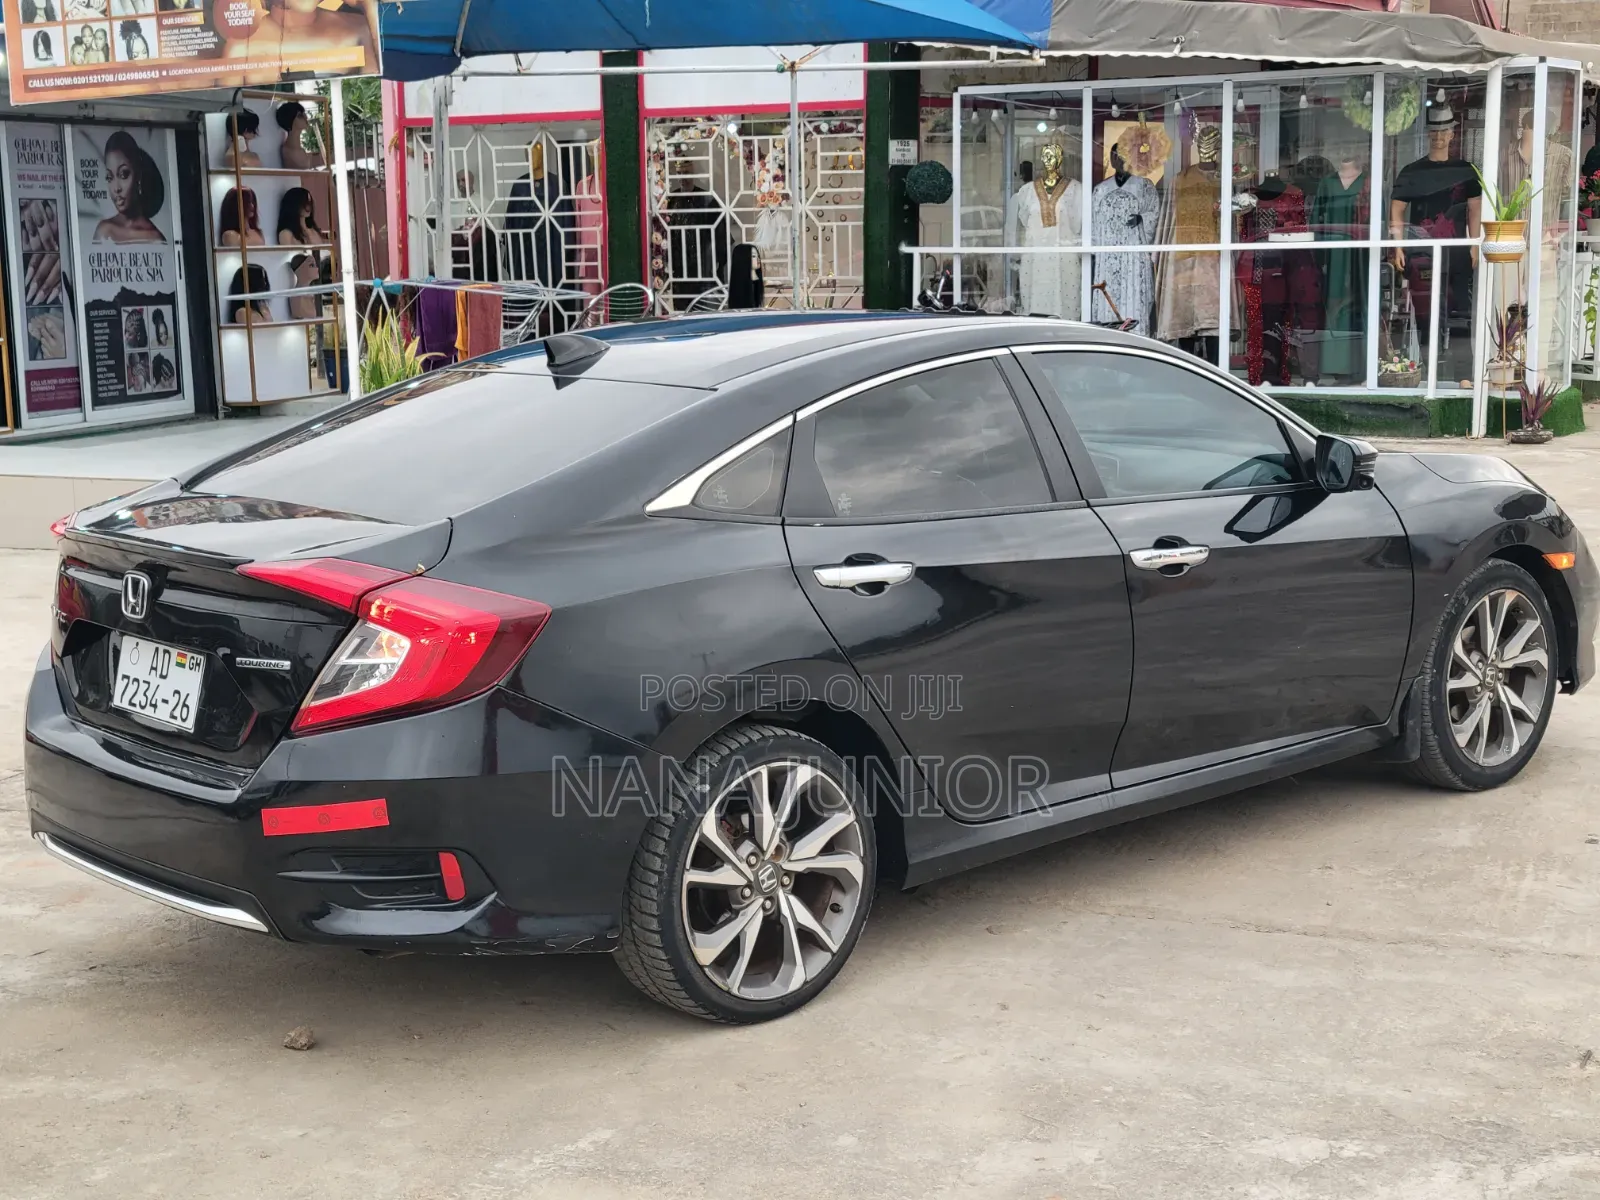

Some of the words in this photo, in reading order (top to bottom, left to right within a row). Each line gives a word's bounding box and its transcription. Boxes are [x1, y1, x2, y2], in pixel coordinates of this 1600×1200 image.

[230, 2, 248, 10] BOOK
[224, 10, 240, 19] YOUR
[240, 9, 255, 18] SEAT
[28, 78, 44, 88] CALL
[45, 78, 54, 86] US
[80, 159, 98, 168] BOOK
[81, 169, 98, 178] YOUR
[82, 180, 96, 189] SEAT
[129, 252, 164, 268] BEAUTY
[91, 268, 133, 283] PARLOUR
[135, 268, 143, 282] &
[147, 268, 164, 282] SPA
[149, 646, 172, 680] AD
[188, 656, 201, 673] GH
[237, 660, 284, 669] TOURING
[120, 674, 190, 722] 7234-26
